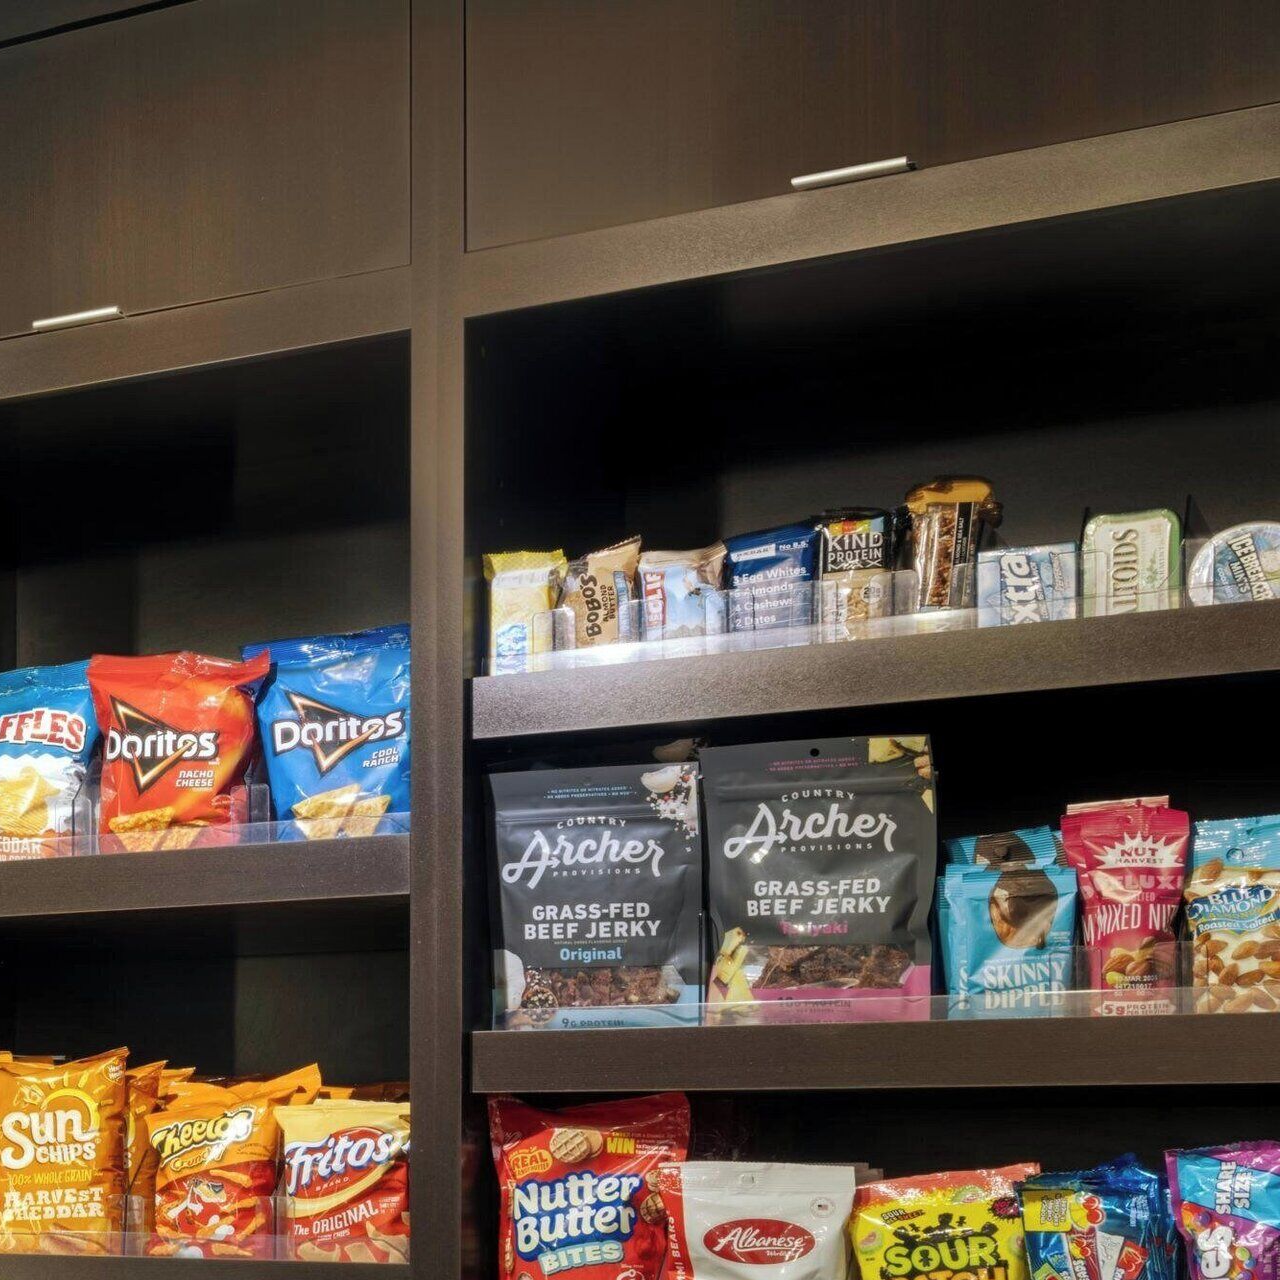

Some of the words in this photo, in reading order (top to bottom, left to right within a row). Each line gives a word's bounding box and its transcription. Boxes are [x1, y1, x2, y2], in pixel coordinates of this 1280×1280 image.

[828, 531, 884, 551] KIND
[828, 548, 882, 563] PROTEIN
[579, 573, 602, 639] BOBO'S
[274, 711, 405, 753] Doritos
[107, 729, 217, 762] Doritos
[372, 747, 398, 760] COOL
[363, 756, 399, 768] RANCH
[175, 778, 214, 788] CHEESE
[178, 769, 214, 779] NACHO
[781, 788, 856, 803] COUNTRY
[556, 816, 627, 830] COUNTRY
[723, 801, 898, 865] Archer
[780, 842, 873, 854] PROVISIONS
[1119, 847, 1159, 858] NUT
[501, 829, 665, 890] Archer
[1114, 855, 1165, 865] HARVEST
[552, 867, 641, 878] PROVISIONS
[754, 877, 881, 897] GRASS-FED
[532, 902, 651, 920] GRASS-FED
[746, 898, 805, 918] BEEF
[812, 895, 891, 915] JERKY
[524, 921, 578, 941] BEEF
[584, 919, 662, 940] JERKY
[1097, 903, 1141, 936] MIXED
[559, 944, 623, 963] Original
[984, 960, 1066, 990] SKINNY
[984, 984, 1066, 1010] DIPPED
[0, 1107, 100, 1170] Sun
[36, 1143, 96, 1165] CHIPS
[285, 1131, 395, 1195] Fritos
[511, 1150, 549, 1171] REAL
[4, 1187, 104, 1208] HARVEST
[514, 1173, 640, 1220] Nutter
[1215, 1161, 1237, 1215] SHARE
[1233, 1169, 1253, 1208] SIZE
[294, 1223, 310, 1236] The
[312, 1201, 379, 1235] ORIGINAL
[515, 1204, 636, 1253] Butter
[713, 1227, 807, 1251] Albanese
[542, 1243, 624, 1272] BITES
[884, 1236, 997, 1274] SOUR
